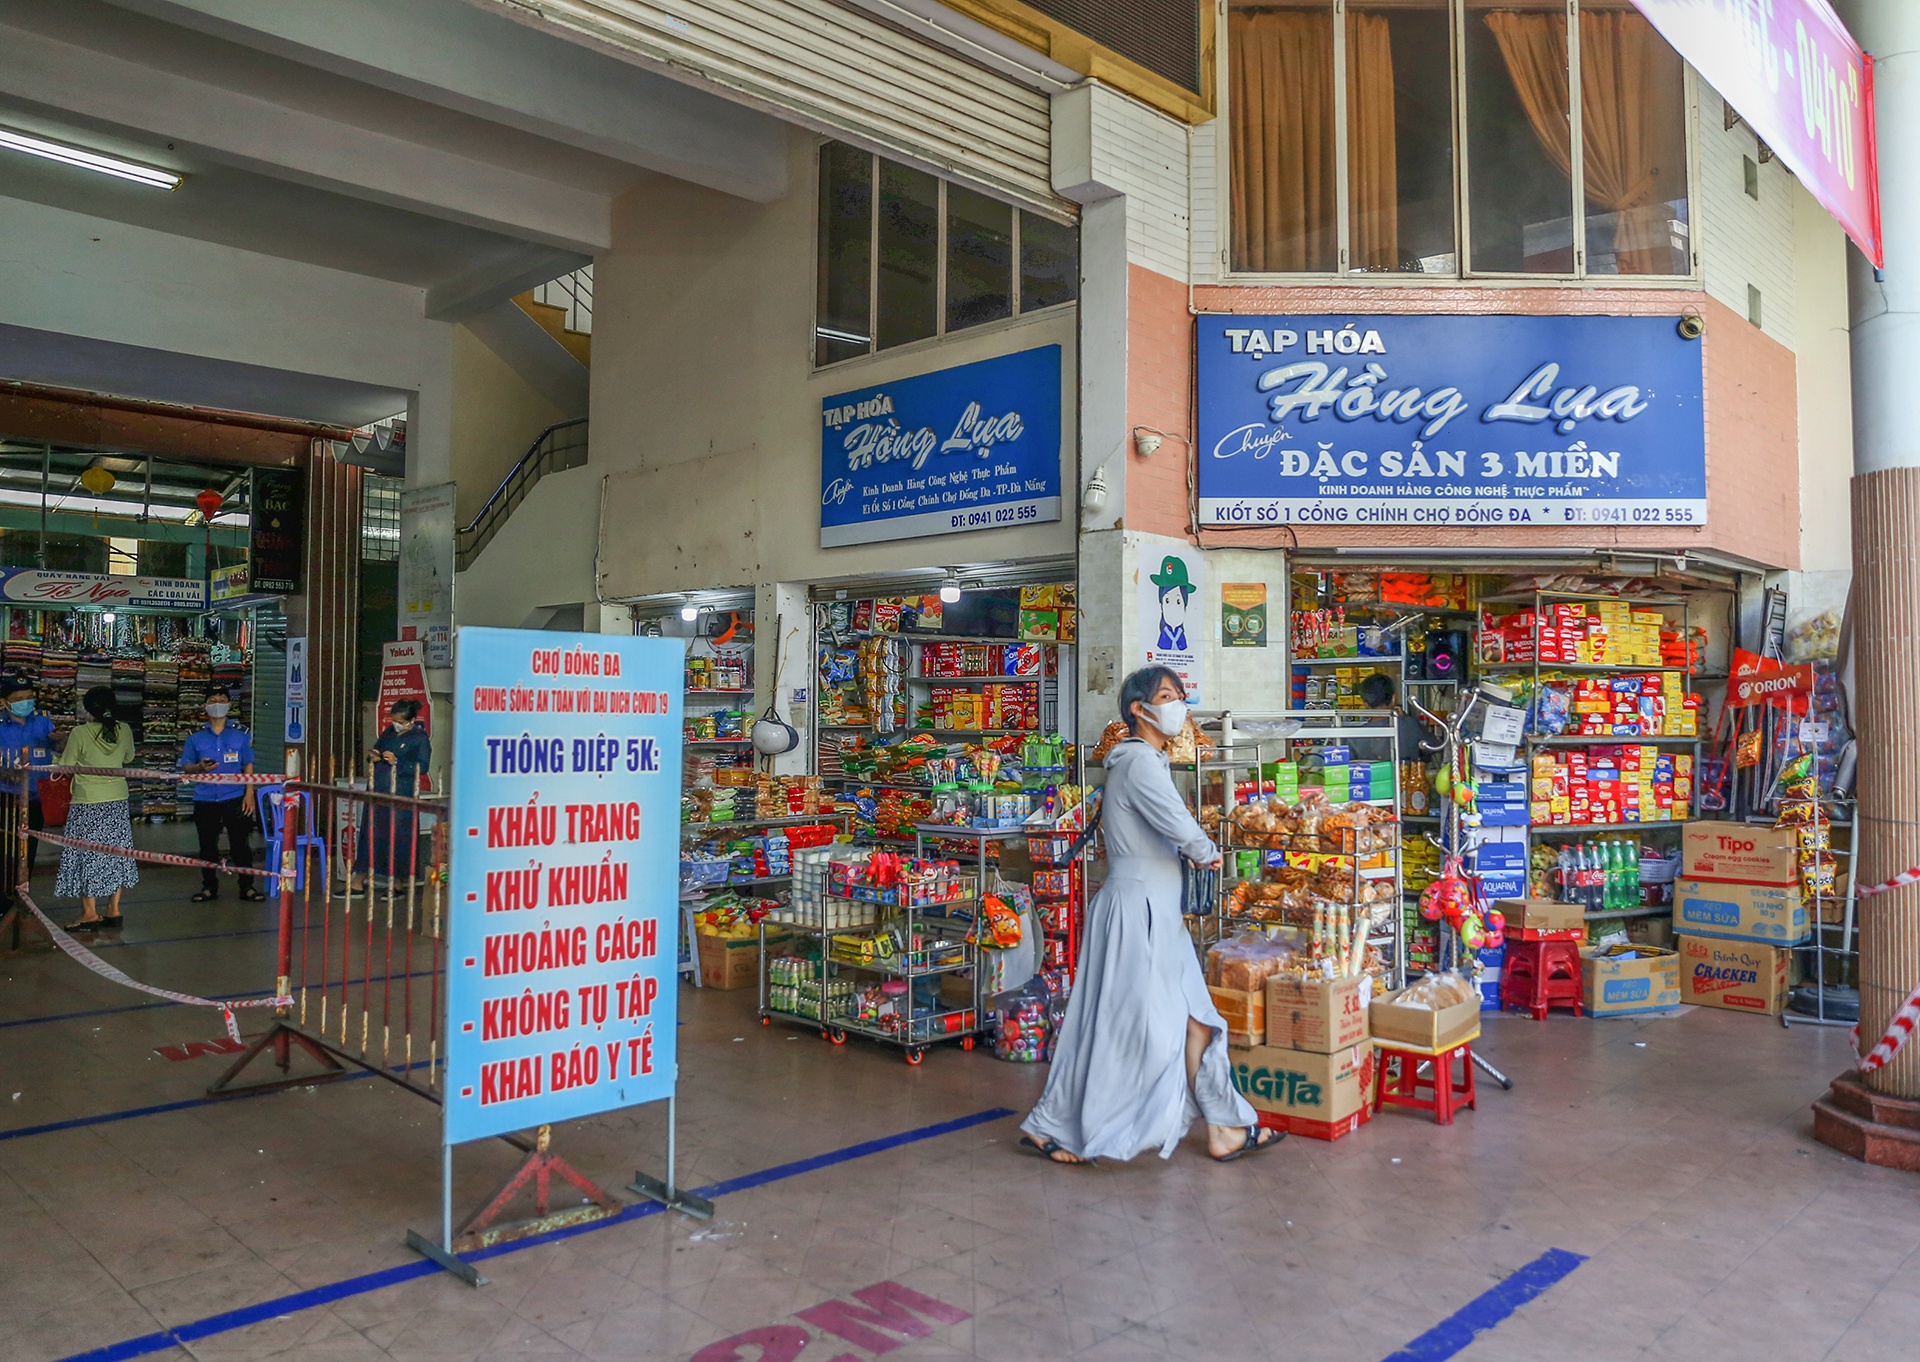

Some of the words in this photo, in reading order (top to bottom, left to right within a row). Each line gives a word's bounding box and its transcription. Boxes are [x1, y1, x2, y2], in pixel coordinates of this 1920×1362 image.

[1225, 329, 1299, 360] TẠP
[1306, 324, 1387, 354] HÓA
[823, 405, 856, 430] TẠP
[857, 393, 894, 420] HÓA
[1257, 360, 1468, 440] Hồng
[1480, 361, 1648, 436] Lụa
[843, 417, 937, 471] Hồng
[940, 400, 1024, 459] Lụa
[1213, 423, 1293, 460] Chuyên
[1280, 441, 1369, 483] ĐẶC
[1379, 440, 1467, 478] SẢN
[1480, 451, 1504, 477] 3
[1515, 440, 1621, 478] MIỀN
[862, 484, 879, 497] Kinh
[882, 481, 903, 494] Doanh
[907, 478, 926, 490] Hàng
[928, 475, 947, 486] Công
[949, 471, 968, 484] Nghệ
[971, 468, 991, 480] Thực
[994, 461, 1017, 476] Phẩm
[1319, 485, 1347, 496] KINH
[1350, 485, 1393, 496] DOANH
[1397, 482, 1431, 496] HÀNG
[1435, 483, 1472, 496] CÔNG
[1513, 485, 1545, 498] THỰC
[1548, 481, 1583, 497] PHẨM
[897, 496, 915, 510] Cổng
[918, 493, 940, 506] Chính
[942, 491, 957, 504] Chợ
[1215, 500, 1252, 522] KIỐT
[1257, 500, 1278, 522] SỐ
[1284, 507, 1291, 521] 1
[1298, 500, 1348, 521] CỔNG
[1356, 502, 1408, 521] CHÍNH
[1413, 505, 1450, 524] CHỢ
[1455, 502, 1503, 521] ĐỐNG
[1509, 508, 1531, 521] ĐA
[1564, 508, 1587, 521] ĐT:
[1592, 508, 1627, 521] 0941
[1633, 508, 1660, 521] 022
[1665, 508, 1693, 521] 555
[951, 514, 966, 528] ĐT:
[968, 511, 991, 525] 0941
[995, 508, 1014, 522] 022
[1018, 505, 1037, 519] 555
[148, 589, 164, 597] CÁC
[175, 581, 200, 589] DOANH
[437, 632, 447, 642] 114
[389, 646, 415, 657] Yakult
[531, 648, 560, 679] CHỢ
[564, 645, 599, 676] ĐỐNG
[604, 654, 620, 676] ĐA
[1754, 676, 1797, 694] ORION
[474, 687, 507, 712] CHUNG
[509, 681, 534, 712] SỐNG
[536, 690, 549, 712] AN
[552, 686, 574, 713] TOÀN
[577, 686, 591, 713] VỚI
[594, 691, 608, 717] ĐẠI
[610, 691, 630, 717] DỊCH
[633, 692, 657, 714] COVID
[659, 693, 669, 714] 19
[486, 732, 564, 774] THÔNG
[572, 732, 620, 779] ĐIỆP
[626, 739, 659, 772] 5K:
[1331, 752, 1343, 761] Fine
[1353, 770, 1364, 778] Fine
[1353, 789, 1364, 797] Fine
[487, 791, 557, 848] KHẨU
[565, 801, 640, 844] TRANG
[1482, 807, 1506, 815] AQUAFINA
[1703, 852, 1727, 860] Cream
[1717, 836, 1754, 854] Tipo
[486, 859, 542, 912] KHỬ
[548, 849, 628, 907] KHUẨN
[1483, 881, 1518, 893] AQUAFINA
[484, 920, 587, 977] KHOẢNG
[595, 915, 657, 963] CÁCH
[1713, 949, 1738, 962] Bánh
[1694, 963, 1757, 983] CRACKER
[482, 987, 569, 1041] KHÔNG
[578, 984, 608, 1031] TỤ
[615, 972, 657, 1025] TẬP
[481, 1055, 542, 1105] KHAI
[551, 1042, 599, 1092] BÁO
[606, 1040, 621, 1080] Y
[628, 1023, 652, 1076] TẾ
